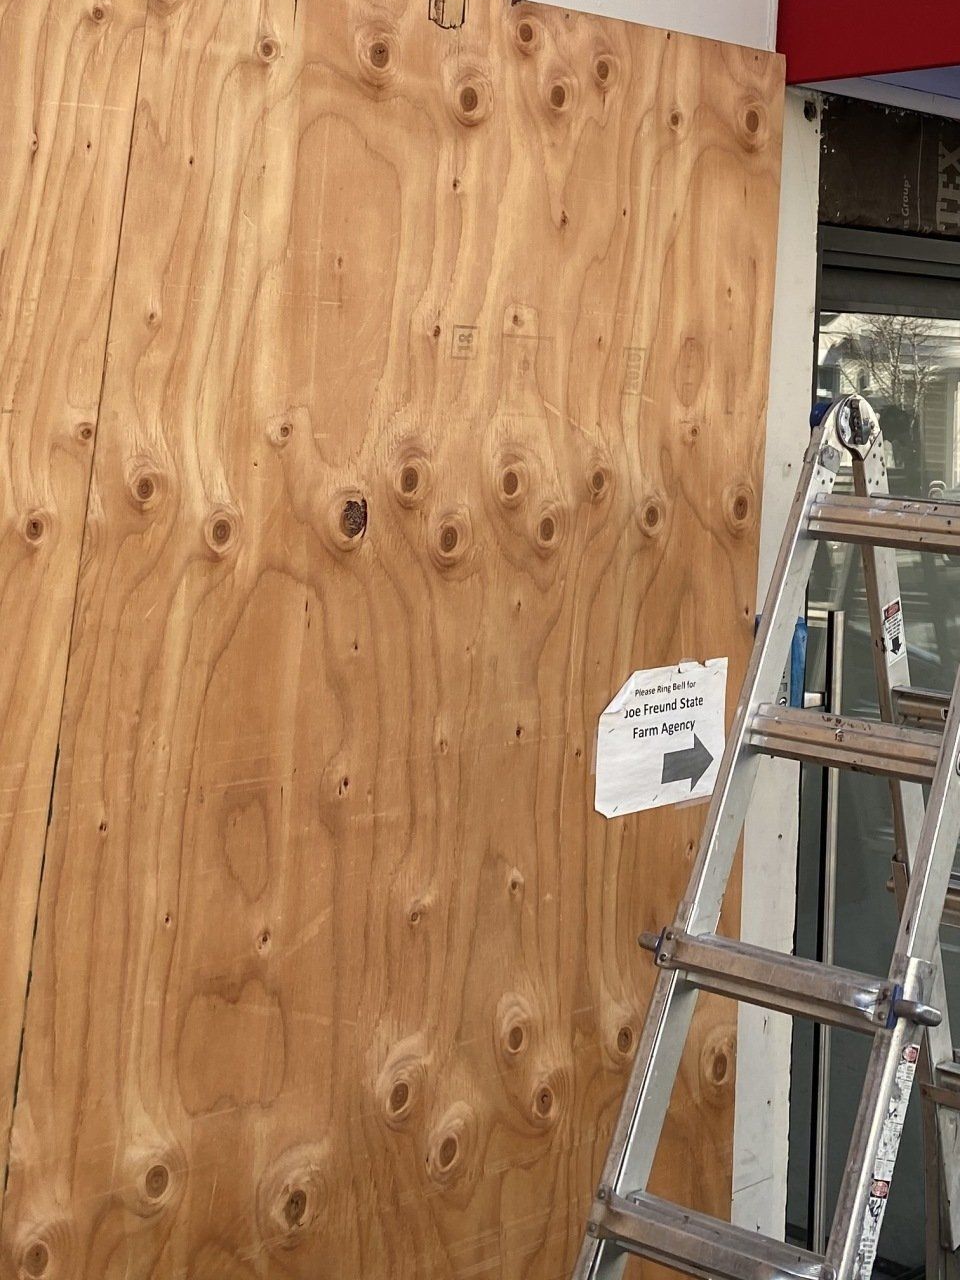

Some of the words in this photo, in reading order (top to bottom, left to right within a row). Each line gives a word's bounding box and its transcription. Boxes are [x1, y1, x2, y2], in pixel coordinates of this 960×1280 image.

[634, 687, 656, 697] Please
[656, 683, 671, 694] Ring
[672, 681, 686, 691] Bell
[687, 680, 696, 689] for
[643, 698, 677, 715] Freund
[679, 695, 704, 709] State
[632, 725, 659, 739] Farm
[660, 719, 696, 736] Agency
